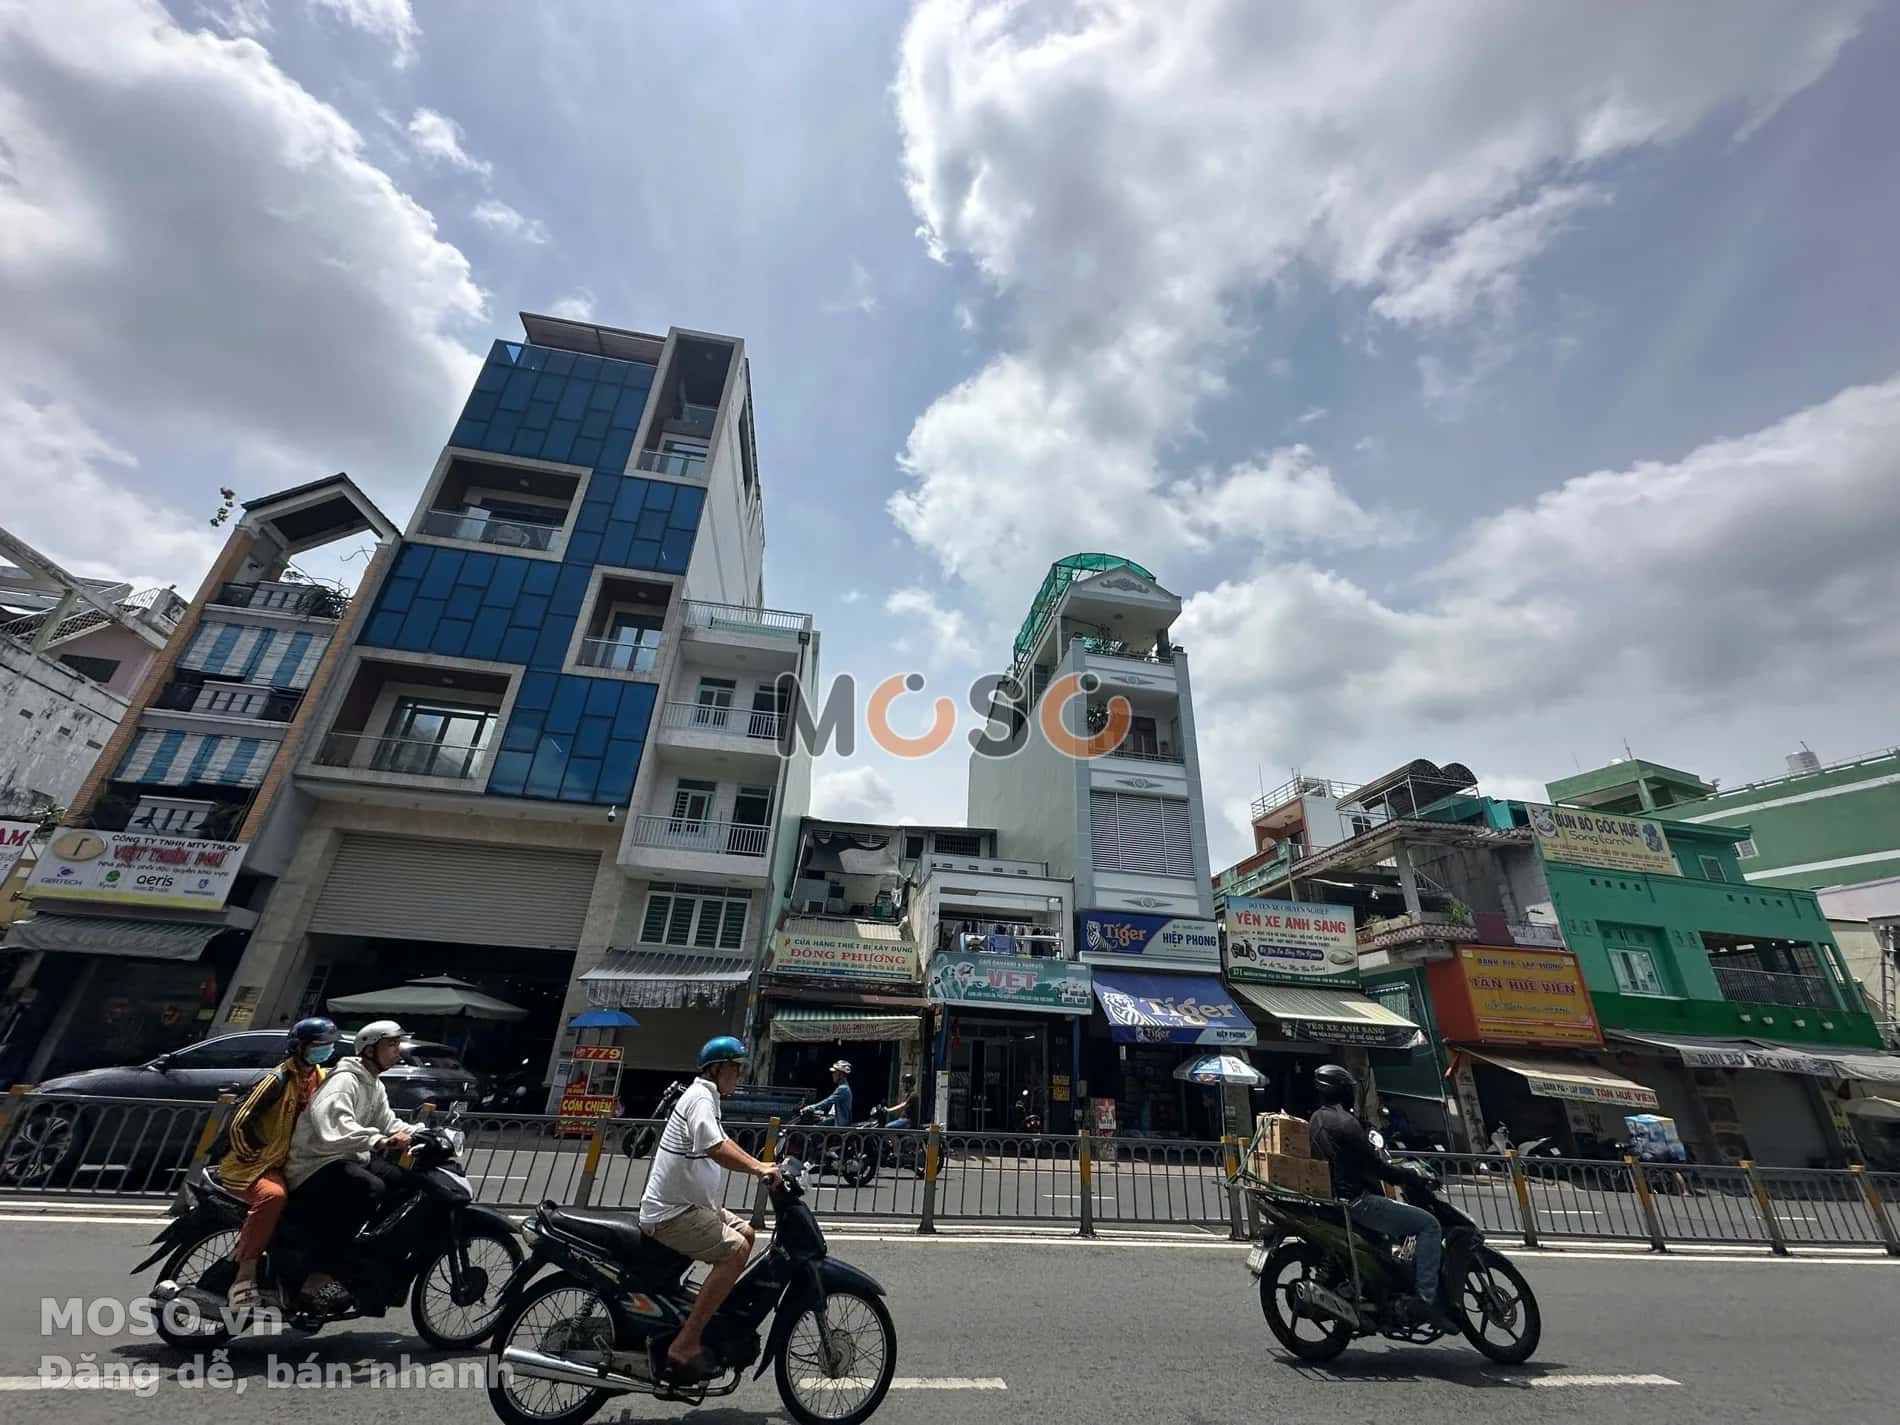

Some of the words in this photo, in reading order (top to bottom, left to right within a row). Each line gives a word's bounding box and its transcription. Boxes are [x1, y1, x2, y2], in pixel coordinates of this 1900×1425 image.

[1555, 811, 1577, 829] BÚN
[1580, 813, 1593, 832] BÒ
[1596, 816, 1619, 836] GỐC
[1620, 820, 1640, 838] HUẾ
[112, 834, 141, 844] CÔNG
[159, 838, 185, 847] TNHH
[187, 841, 210, 849] MTV
[136, 873, 174, 887] aeris
[1236, 911, 1261, 927] YÊN
[1265, 915, 1281, 928] XE
[1285, 917, 1310, 931] ANH
[1104, 923, 1147, 946] Tiger
[1162, 931, 1183, 947] HIỆP
[1186, 933, 1217, 947] PHONG
[794, 938, 811, 947] CỬA
[813, 938, 835, 948] HÀNG
[837, 940, 860, 949] THIẾT
[874, 943, 888, 951] XÂY
[790, 947, 835, 960] ĐÔNG
[841, 951, 905, 964] PHƯƠNG
[1140, 997, 1236, 1025] Tiger
[1146, 1027, 1171, 1042] Tiger
[1216, 1029, 1228, 1040] HIỆP
[1228, 1030, 1247, 1039] PHONG
[587, 1047, 621, 1059] 779
[562, 1098, 583, 1112] CƠM
